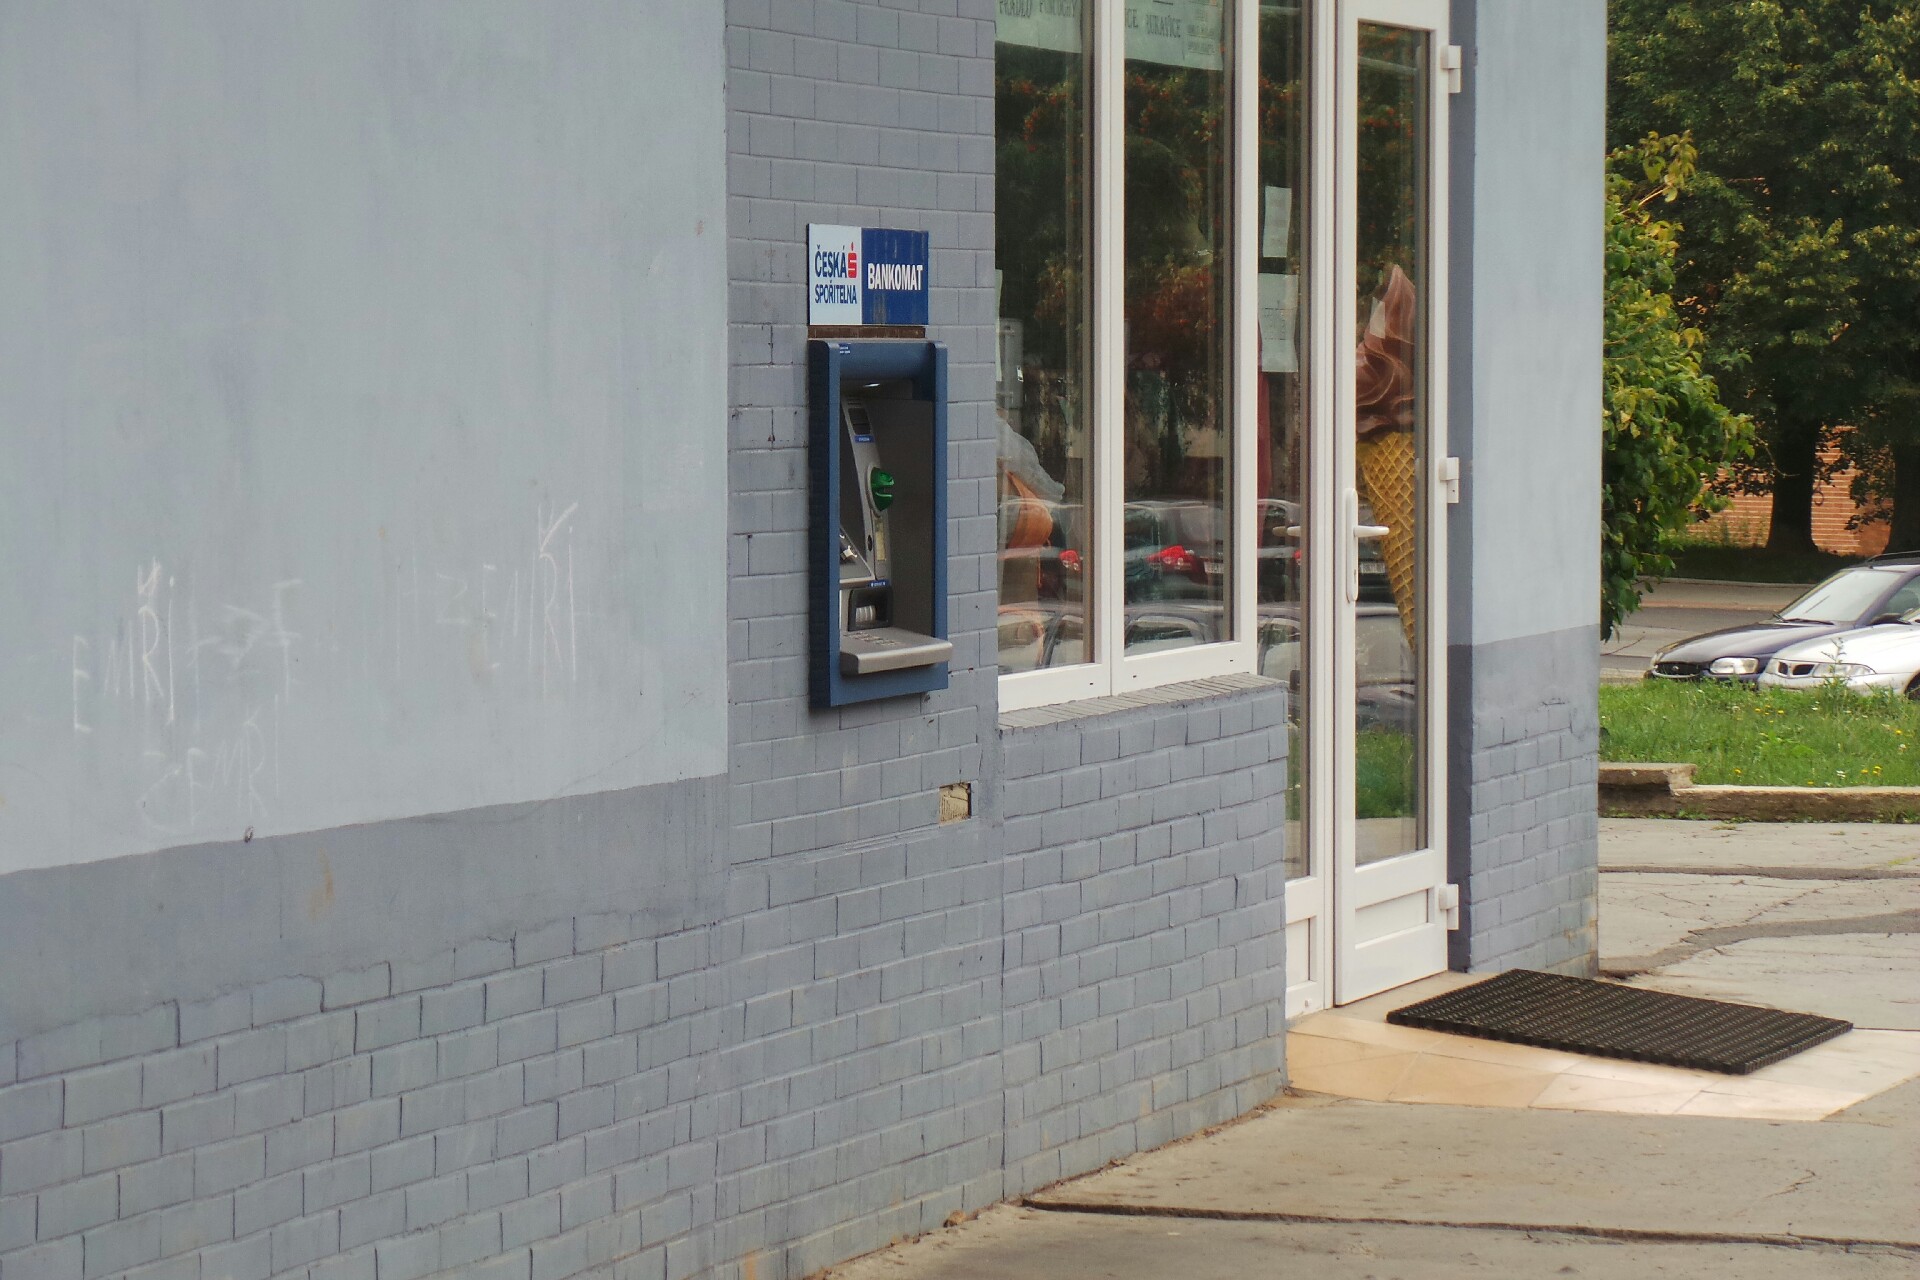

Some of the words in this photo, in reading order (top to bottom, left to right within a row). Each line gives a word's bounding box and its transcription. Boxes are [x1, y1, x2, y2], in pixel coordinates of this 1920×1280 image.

[815, 244, 848, 279] ČESKÁ
[867, 262, 924, 291] BANKOMAT
[814, 279, 858, 304] SPOŘITELNA
